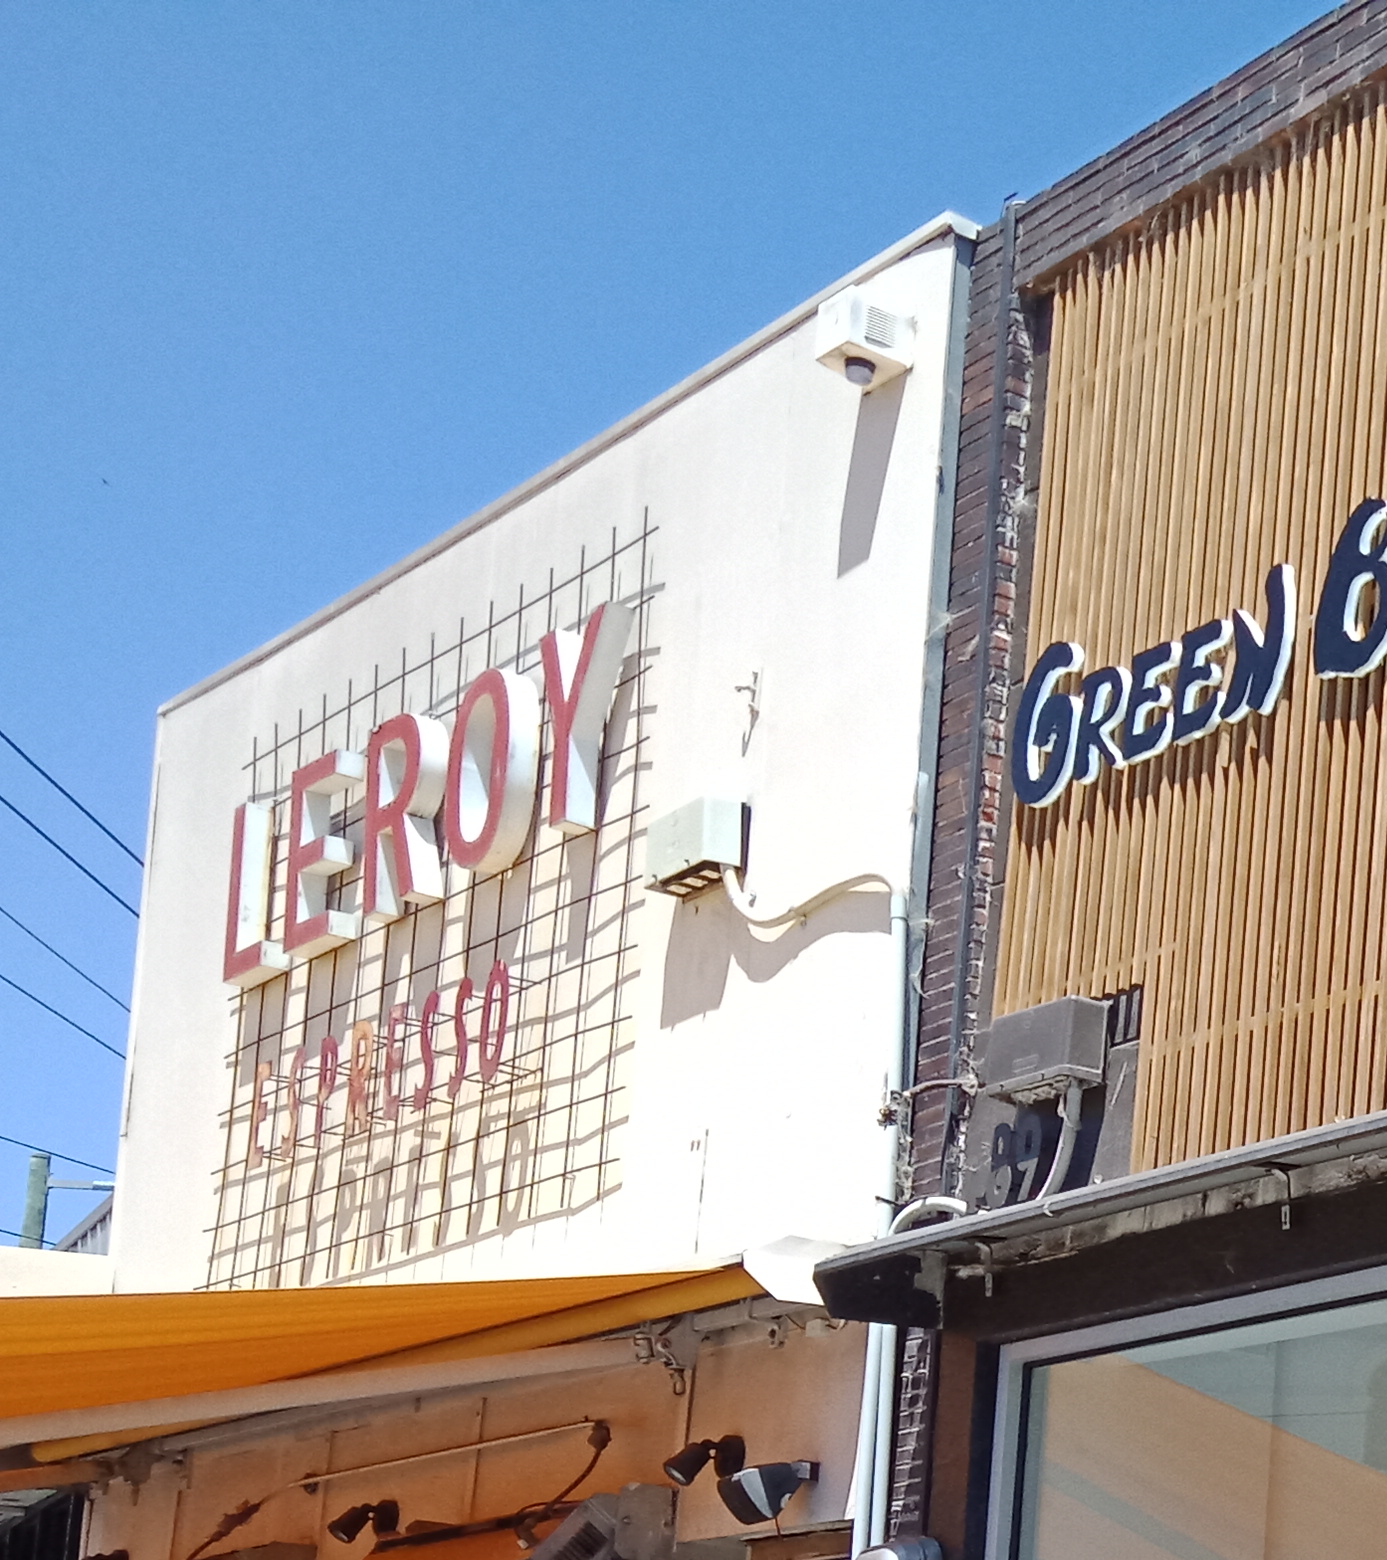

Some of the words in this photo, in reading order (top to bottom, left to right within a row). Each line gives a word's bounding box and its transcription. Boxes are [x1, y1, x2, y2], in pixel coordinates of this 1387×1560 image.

[223, 600, 635, 988] LEROY
[1011, 563, 1296, 808] GREEN
[248, 958, 509, 1168] ESPRESSO
